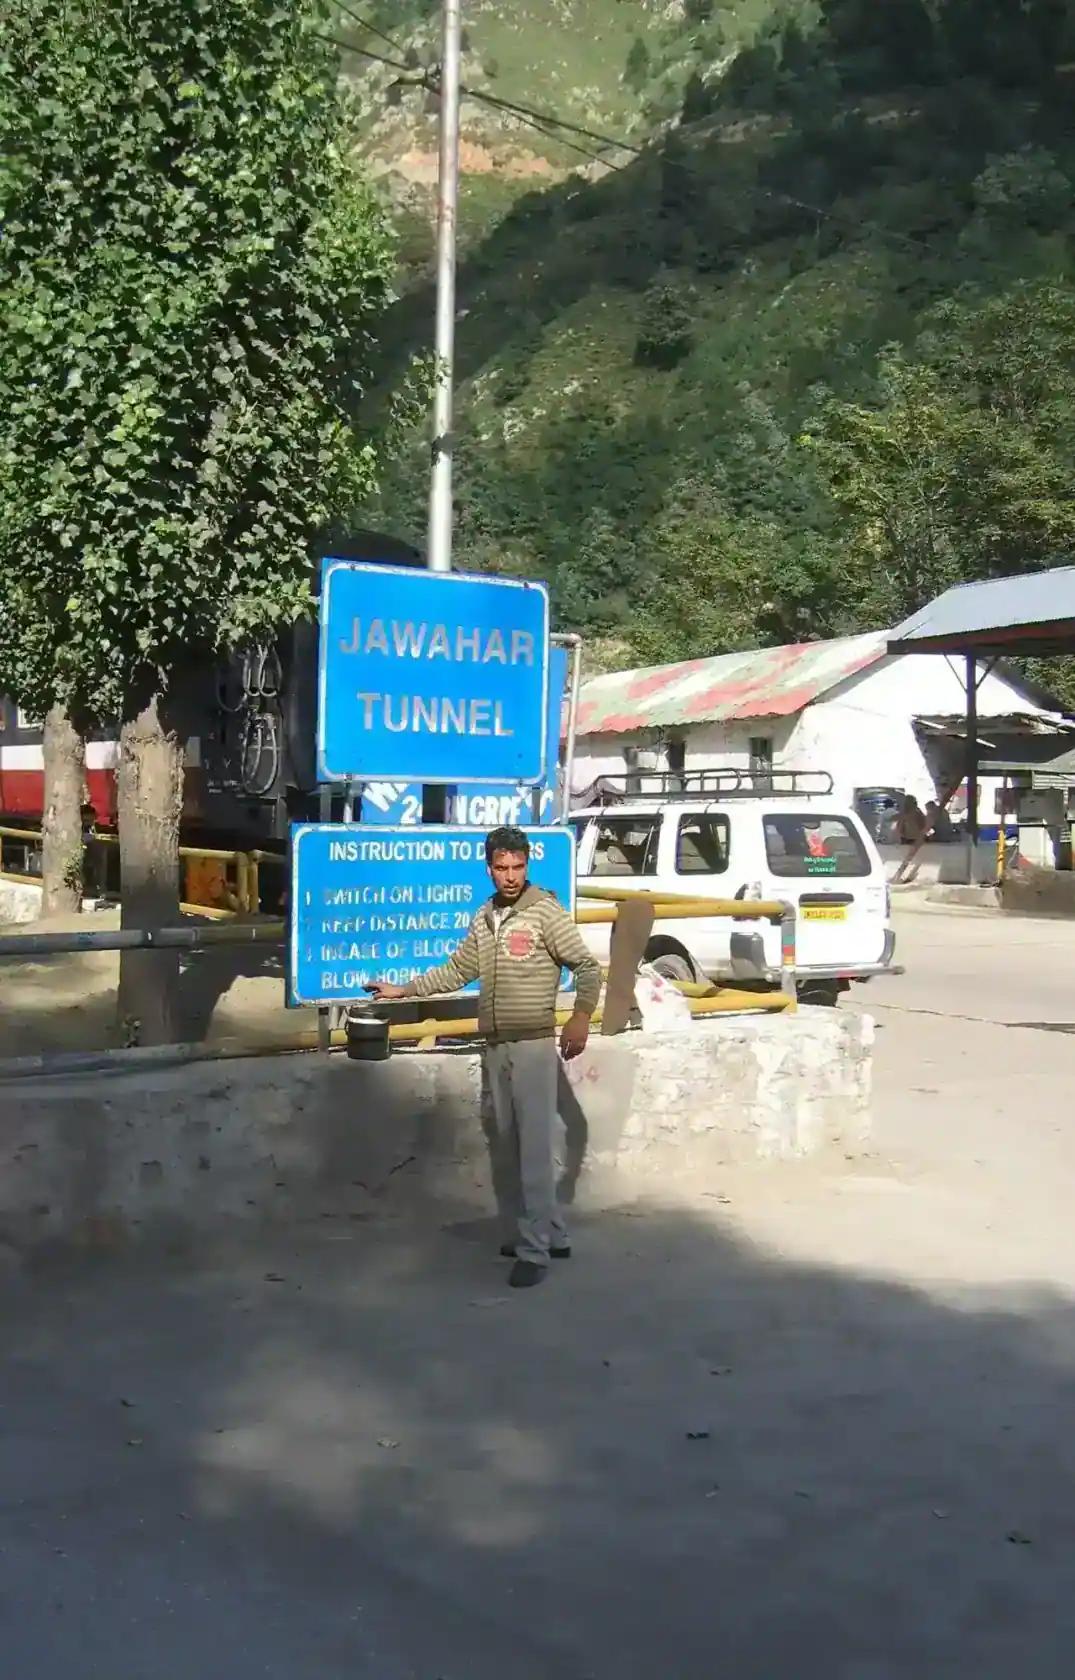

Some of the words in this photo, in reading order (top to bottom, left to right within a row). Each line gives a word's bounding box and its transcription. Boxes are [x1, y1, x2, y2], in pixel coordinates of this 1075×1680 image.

[339, 617, 534, 667] JAWAHAR
[356, 692, 514, 737] TUNNEL
[329, 841, 445, 862] INSTRUCTION
[449, 841, 472, 861] TO
[418, 884, 473, 904] LIGHTS
[370, 912, 449, 932] DISTANCE
[321, 969, 370, 990] BLOW
